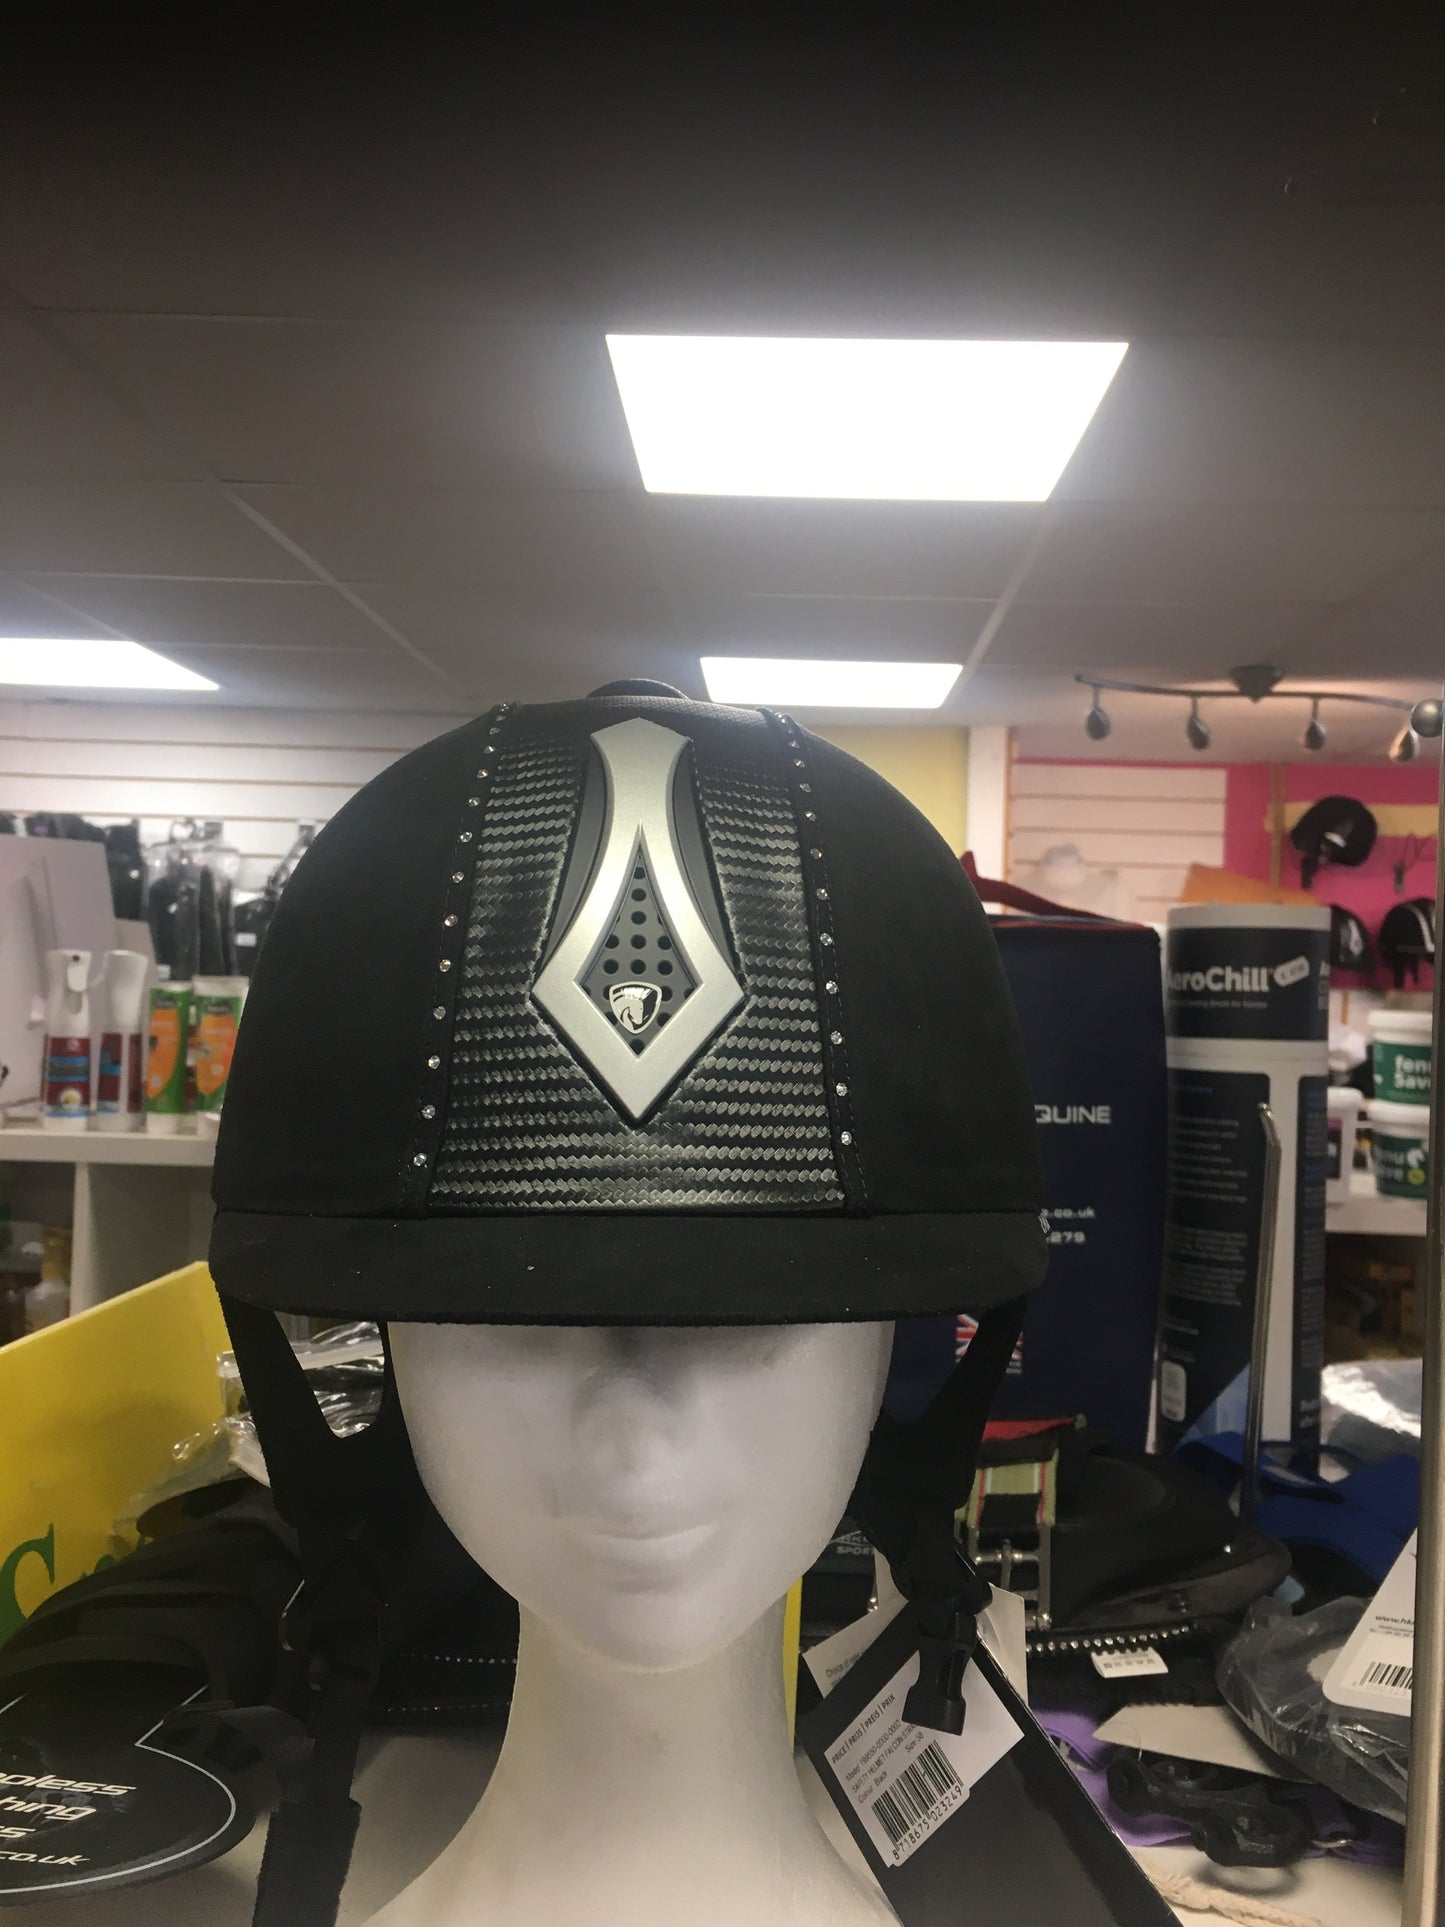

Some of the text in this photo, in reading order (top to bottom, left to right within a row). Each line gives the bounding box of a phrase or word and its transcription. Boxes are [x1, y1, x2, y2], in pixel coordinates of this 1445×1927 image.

[1395, 1055, 1431, 1074] fen
[1394, 1072, 1431, 1090] Sav
[832, 1745, 848, 1764] PRICE
[864, 1710, 880, 1729] PREIS
[881, 1693, 896, 1710] PRIX
[901, 1722, 918, 1740] STRA
